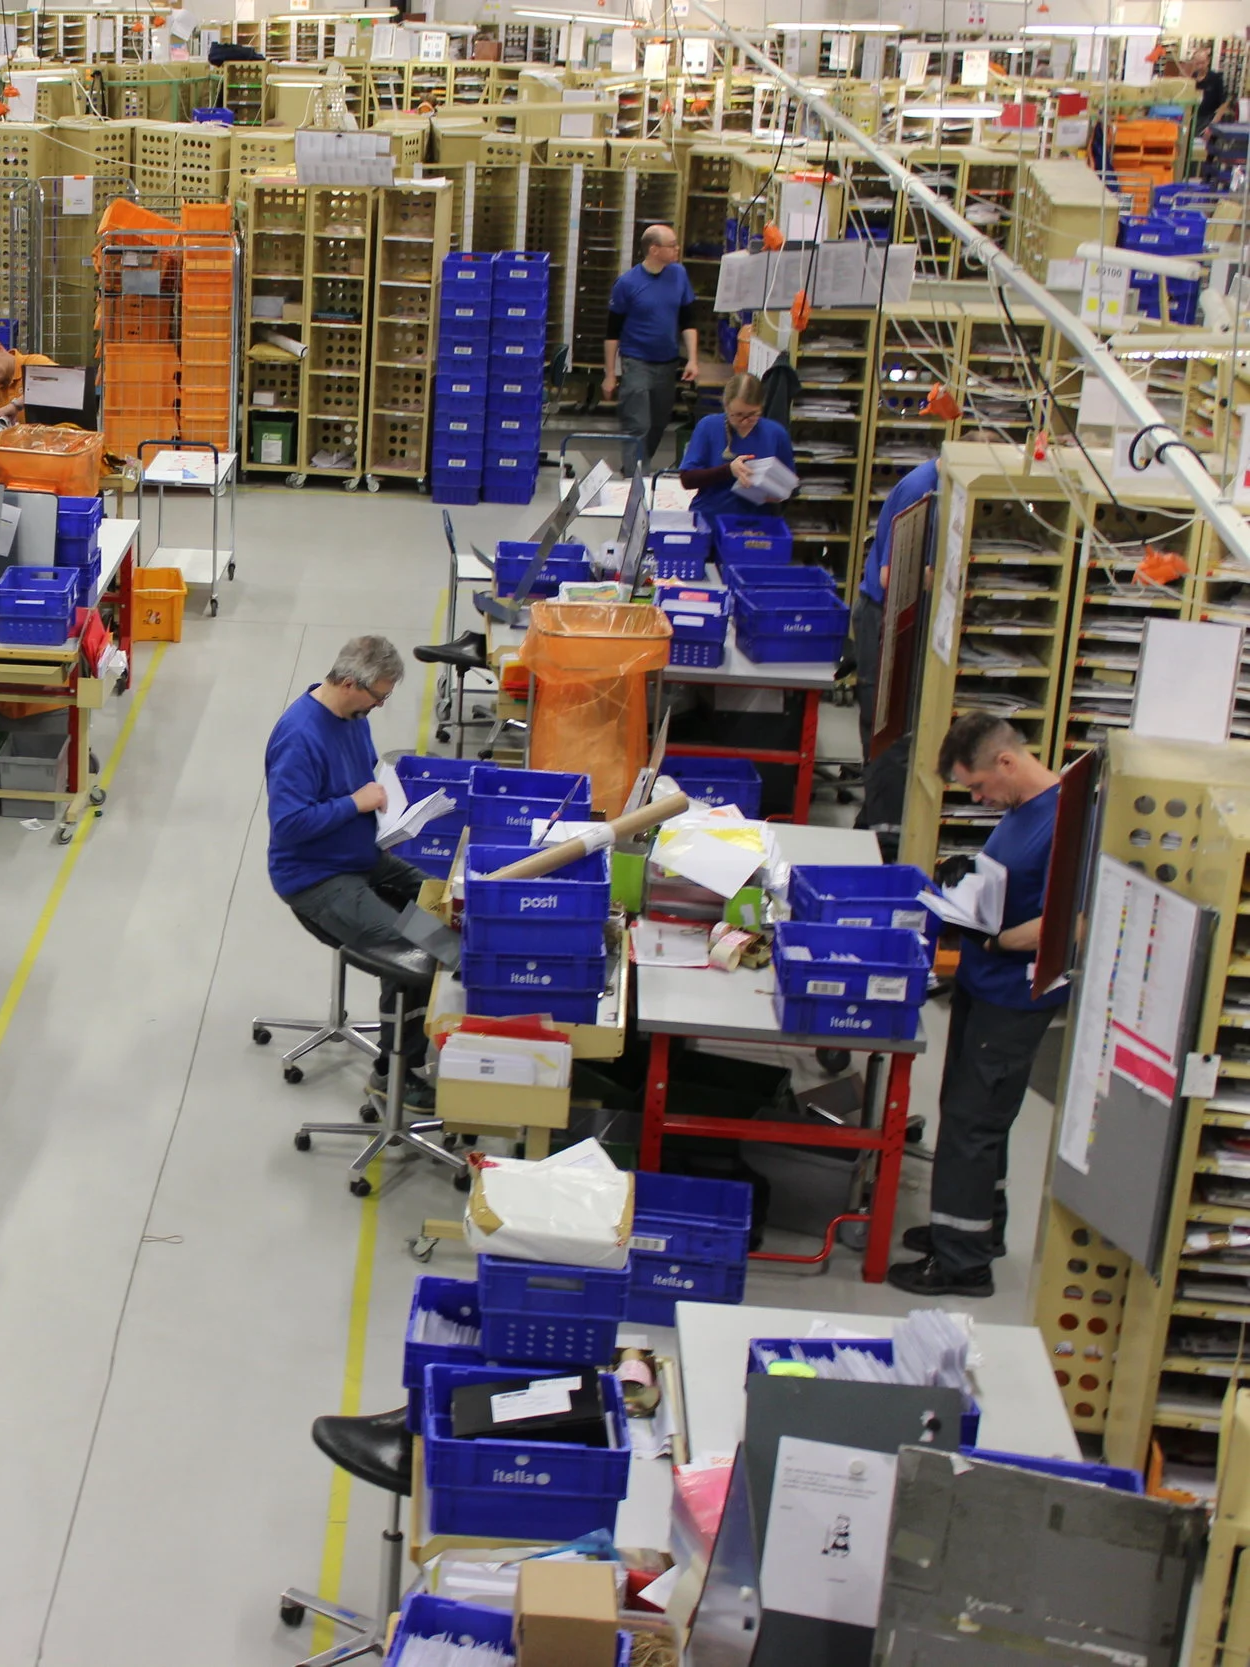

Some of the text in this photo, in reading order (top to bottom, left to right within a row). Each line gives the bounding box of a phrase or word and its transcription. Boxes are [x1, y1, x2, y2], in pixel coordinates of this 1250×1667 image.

[520, 894, 558, 912] posti
[511, 972, 541, 984] itella
[830, 1016, 861, 1028] itella
[653, 1273, 683, 1288] itella
[493, 1468, 536, 1484] itella
